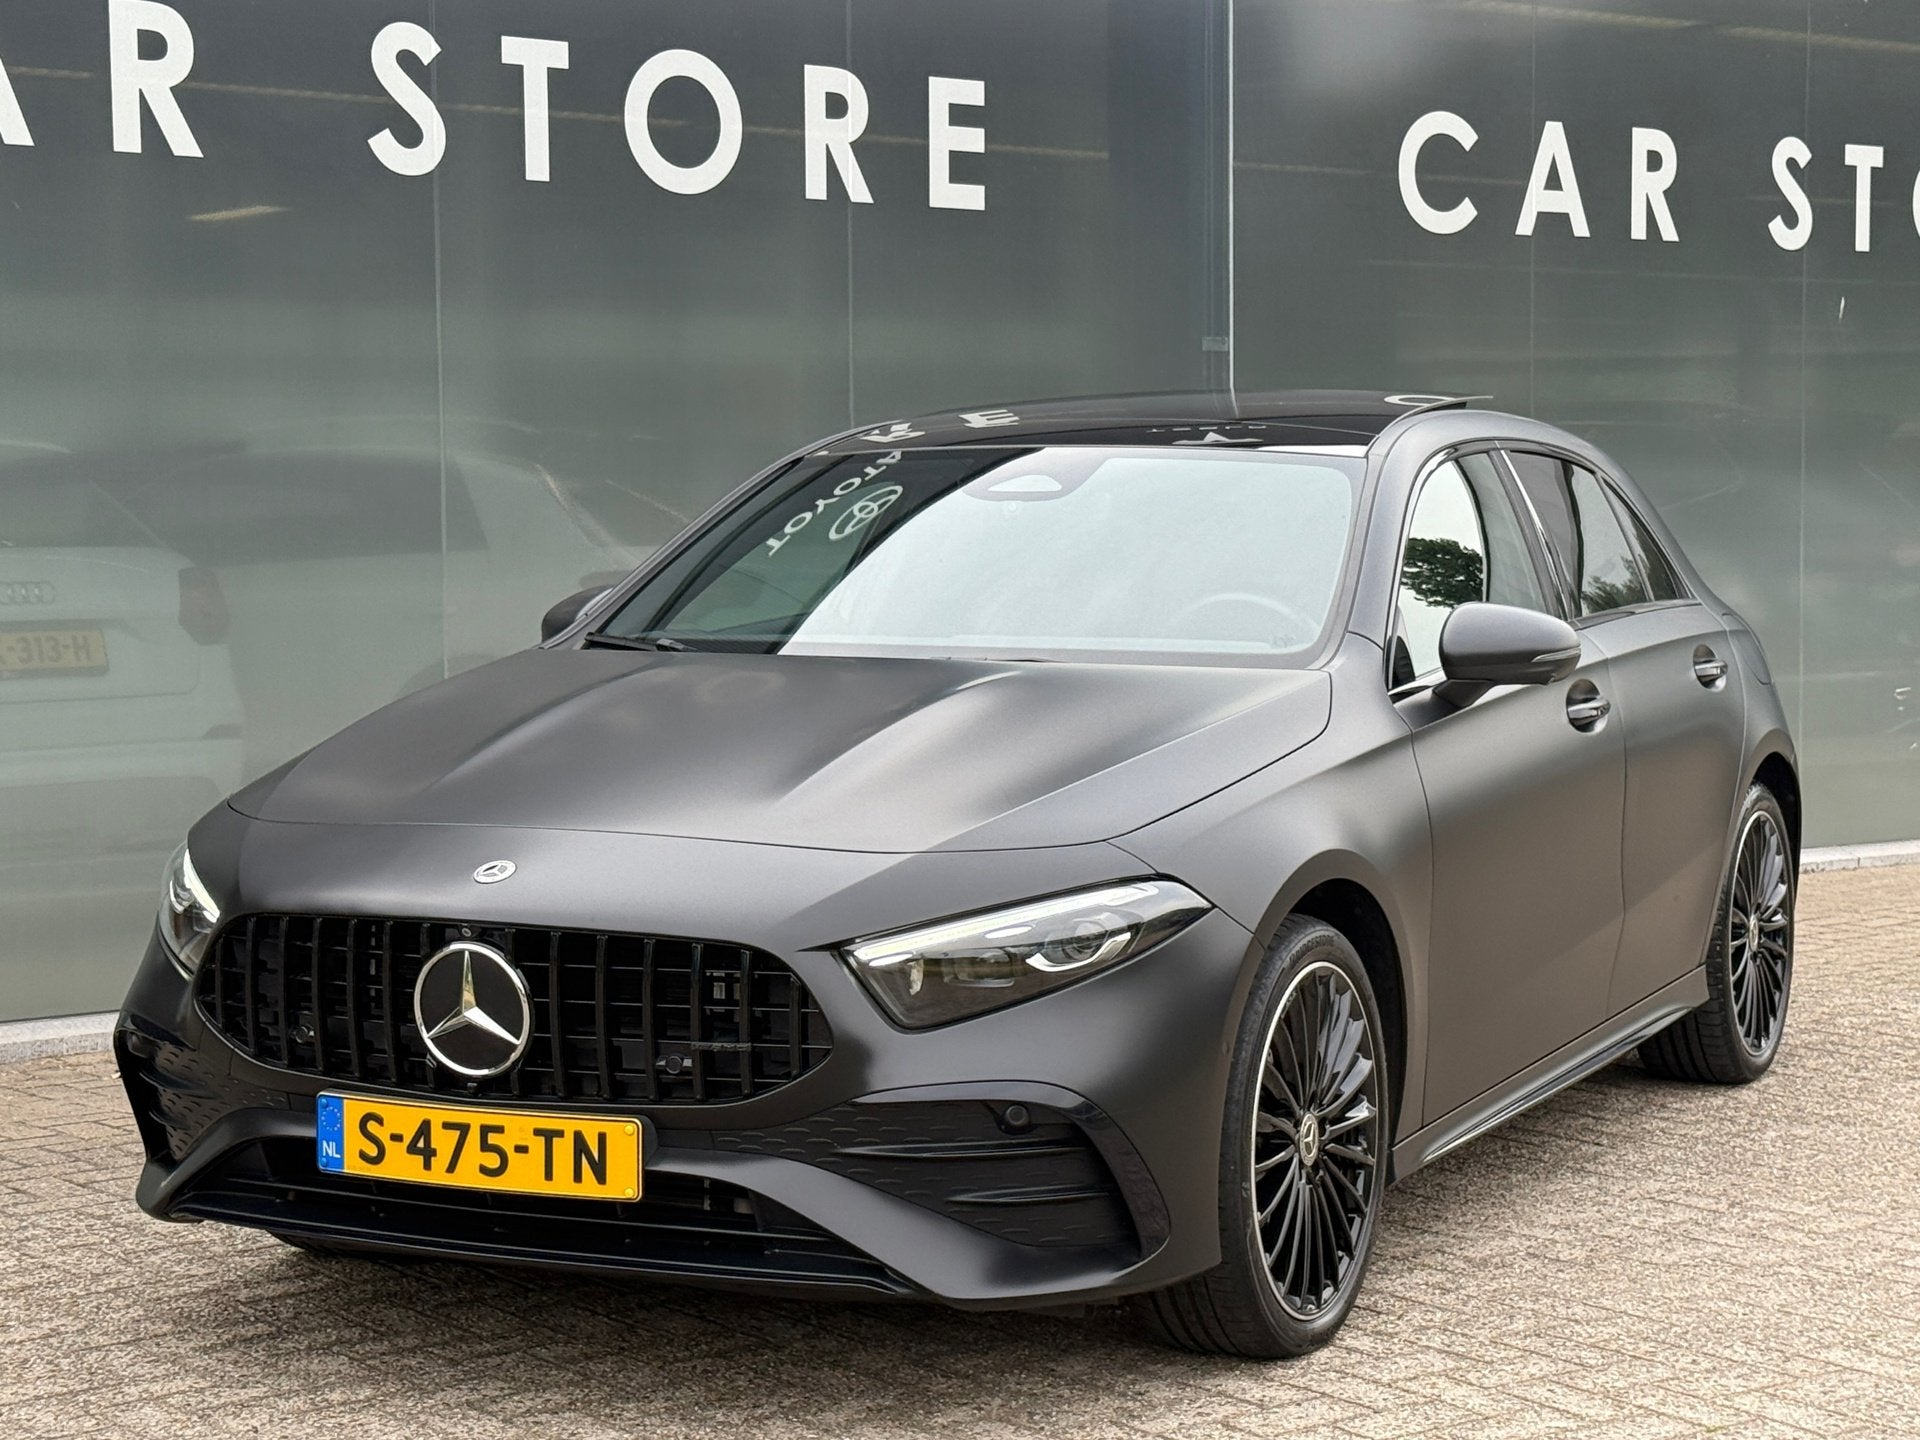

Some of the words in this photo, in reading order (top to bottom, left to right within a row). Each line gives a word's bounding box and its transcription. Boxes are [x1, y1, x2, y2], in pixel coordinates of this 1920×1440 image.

[368, 21, 987, 212] STORE
[1398, 110, 1680, 242] CAR
[1767, 136, 1920, 253] ST
[0, 634, 91, 666] -313-H
[322, 1141, 341, 1159] NL
[358, 1111, 608, 1186] S-475-TN
